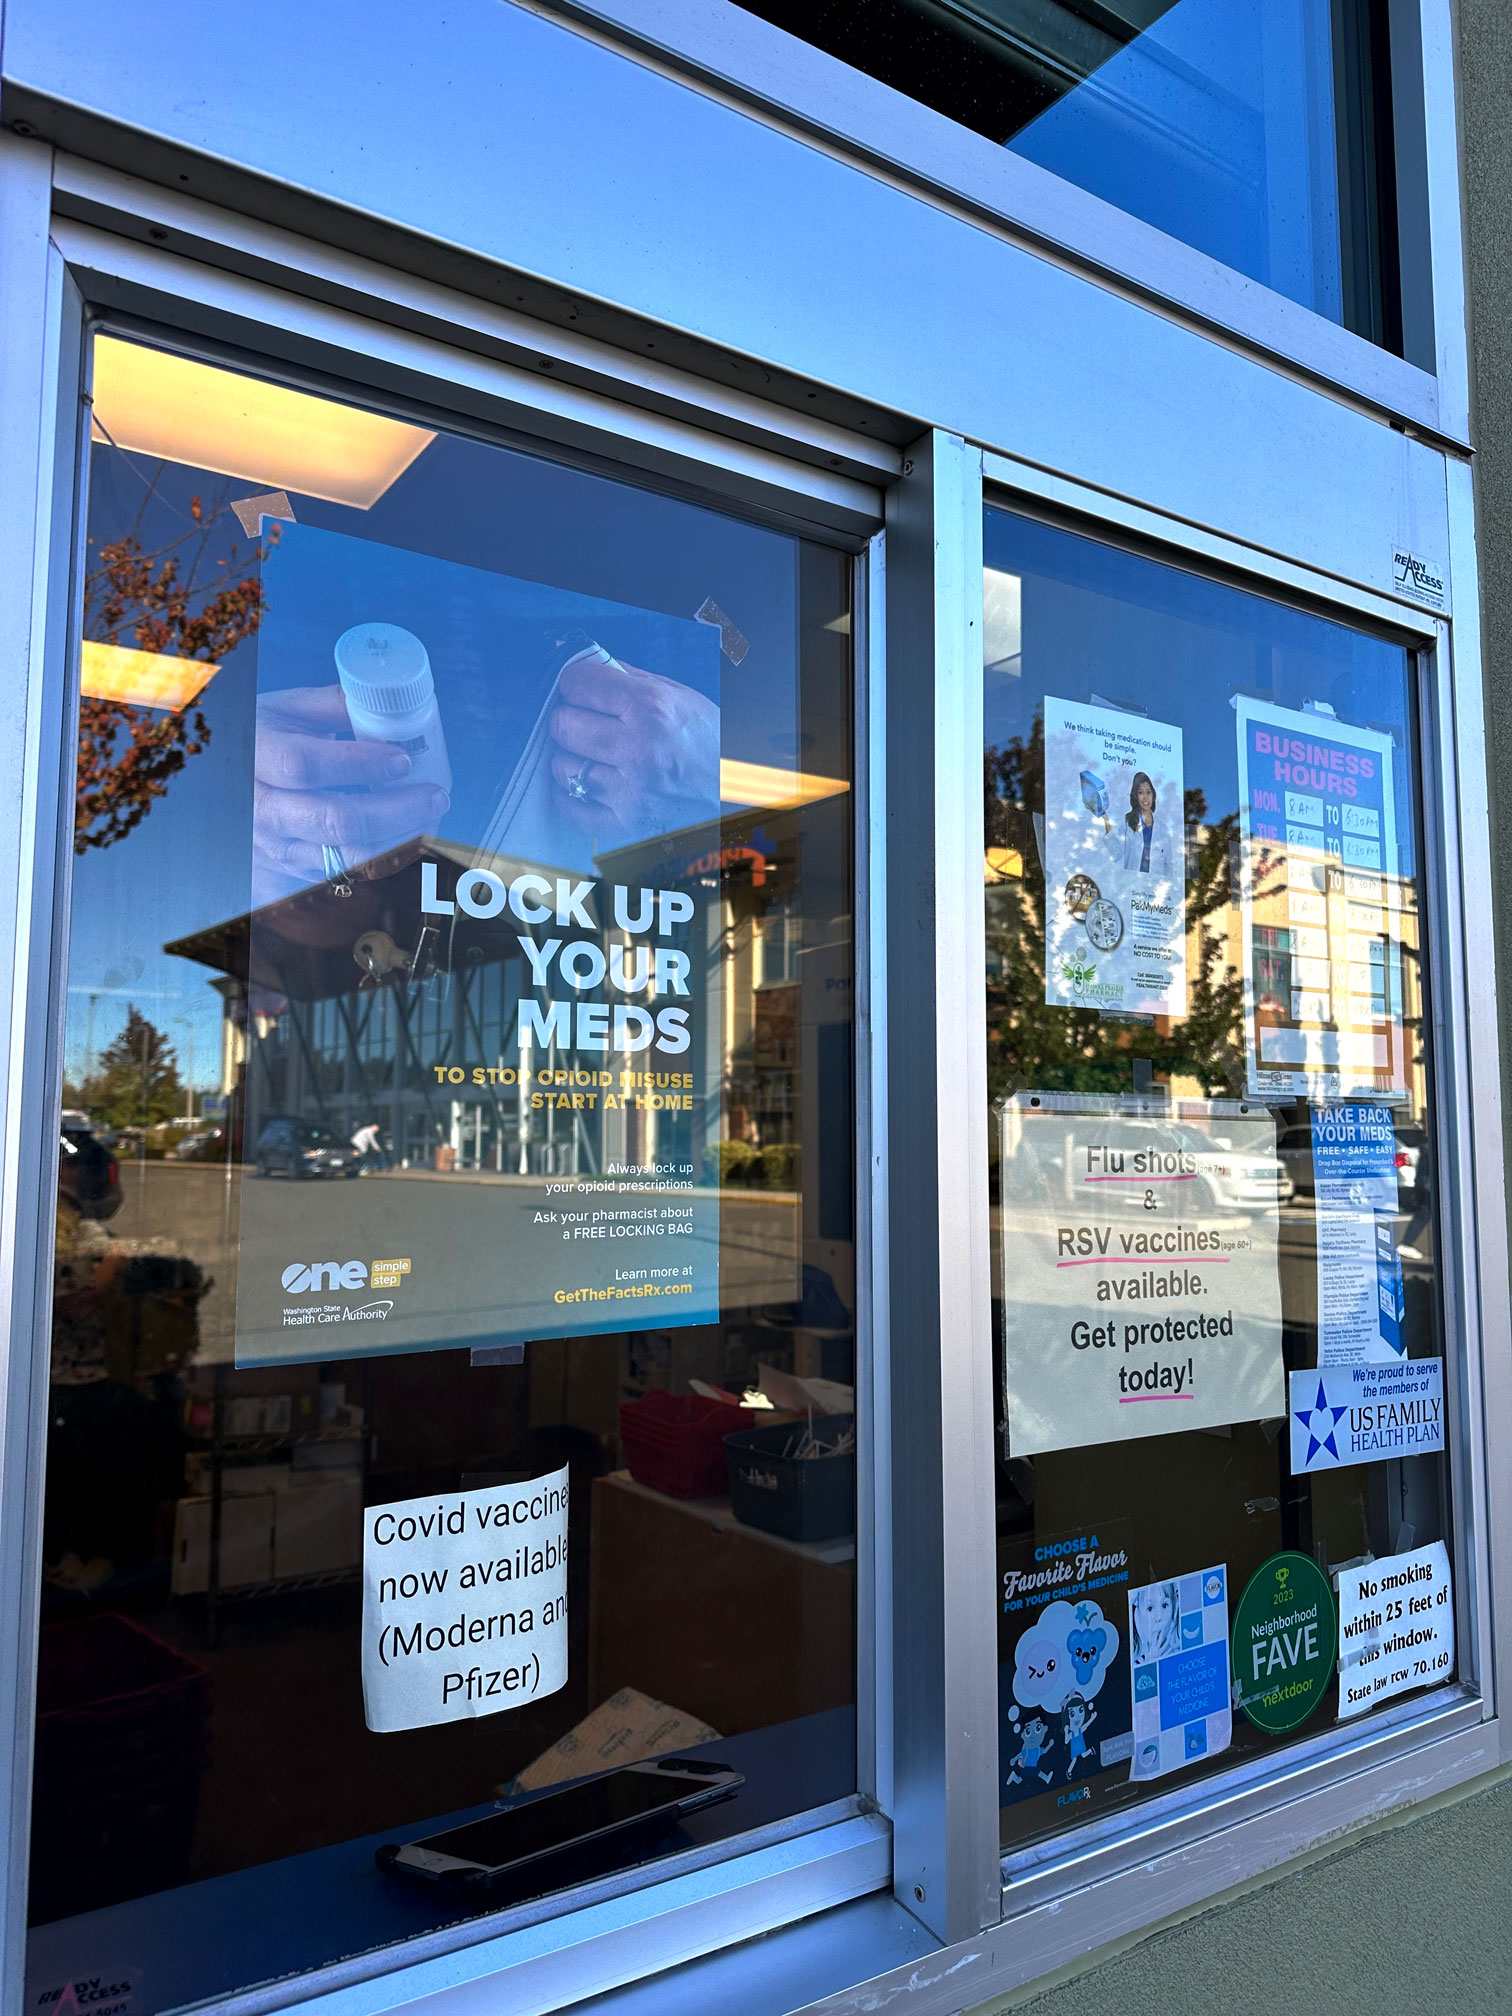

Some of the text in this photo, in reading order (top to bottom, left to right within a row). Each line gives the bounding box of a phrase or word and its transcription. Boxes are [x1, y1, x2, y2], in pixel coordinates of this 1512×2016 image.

[1394, 553, 1426, 574] READY
[1064, 720, 1172, 753] We think taking medication should
[1104, 740, 1137, 754] be simple.
[1102, 752, 1137, 766] Don't you?
[1255, 731, 1375, 778] BUSINESS
[1275, 760, 1358, 798] HOURS
[1254, 789, 1280, 813] MON.
[1326, 805, 1339, 826] TO
[1327, 838, 1340, 858] TO
[1328, 870, 1342, 890] TO
[420, 862, 695, 936] LOCK UP
[517, 936, 691, 996] YOUR
[1260, 958, 1284, 980] SAT.
[517, 998, 691, 1054] MEDS
[434, 1066, 694, 1089] TO STOP OPIOID MISUSE
[530, 1092, 693, 1110] START AT HOME
[1314, 1108, 1391, 1124] TAKE BACK
[1315, 1125, 1392, 1142] YOUR MEDS
[1086, 1146, 1125, 1174] Flu
[1133, 1149, 1197, 1174] shots
[1317, 1145, 1393, 1155] FREE SAFE EASY
[608, 1162, 694, 1176] Always lock up
[546, 1179, 694, 1196] your opioid prescriptions
[1143, 1189, 1158, 1210] &
[534, 1206, 694, 1225] Ask your pharmacist about
[562, 1222, 693, 1240] a FREE LOCKING BAG
[1057, 1227, 1112, 1256] RSV
[1119, 1226, 1221, 1254] vaccines
[1220, 1242, 1236, 1251] (age
[281, 1260, 409, 1294] one simple
[374, 1275, 397, 1286] step
[615, 1265, 693, 1281] Learn more at
[1096, 1270, 1208, 1301] available.
[554, 1283, 693, 1304] GetTheFactsRx.com
[283, 1306, 322, 1316] Washington
[283, 1306, 388, 1326] Health Care Authority
[1070, 1310, 1234, 1353] Get protected
[1118, 1358, 1194, 1394] today!
[1352, 1363, 1438, 1382] We're proud to serve
[1362, 1379, 1429, 1398] the members of
[1350, 1398, 1442, 1432] US FAMILY
[1351, 1422, 1440, 1452] HEALTH PLAN
[374, 1501, 466, 1546] Covid
[1034, 1534, 1100, 1561] CHOOSE A
[379, 1568, 449, 1604] now
[1004, 1550, 1128, 1600] Favorite Flavor
[1358, 1562, 1433, 1600] No smoking
[1004, 1570, 1129, 1614] FOR YOUR CHILD'S MEDICINE
[1273, 1588, 1294, 1606] 2023
[1251, 1604, 1318, 1640] Neighborhood
[1344, 1585, 1448, 1639] within 25 feet of
[378, 1608, 535, 1667] (Moderna
[1252, 1622, 1320, 1680] FAVE
[1383, 1626, 1438, 1655] window.
[442, 1652, 541, 1704] Pfizer)
[1168, 1666, 1217, 1690] THE FLAVOR OF
[1178, 1656, 1207, 1674] CHOOSE
[1348, 1652, 1449, 1704] State law rcw 70.160
[1171, 1690, 1190, 1704] YOUR
[1178, 1698, 1210, 1715] MEDICINE
[1262, 1678, 1314, 1708] nextdoor
